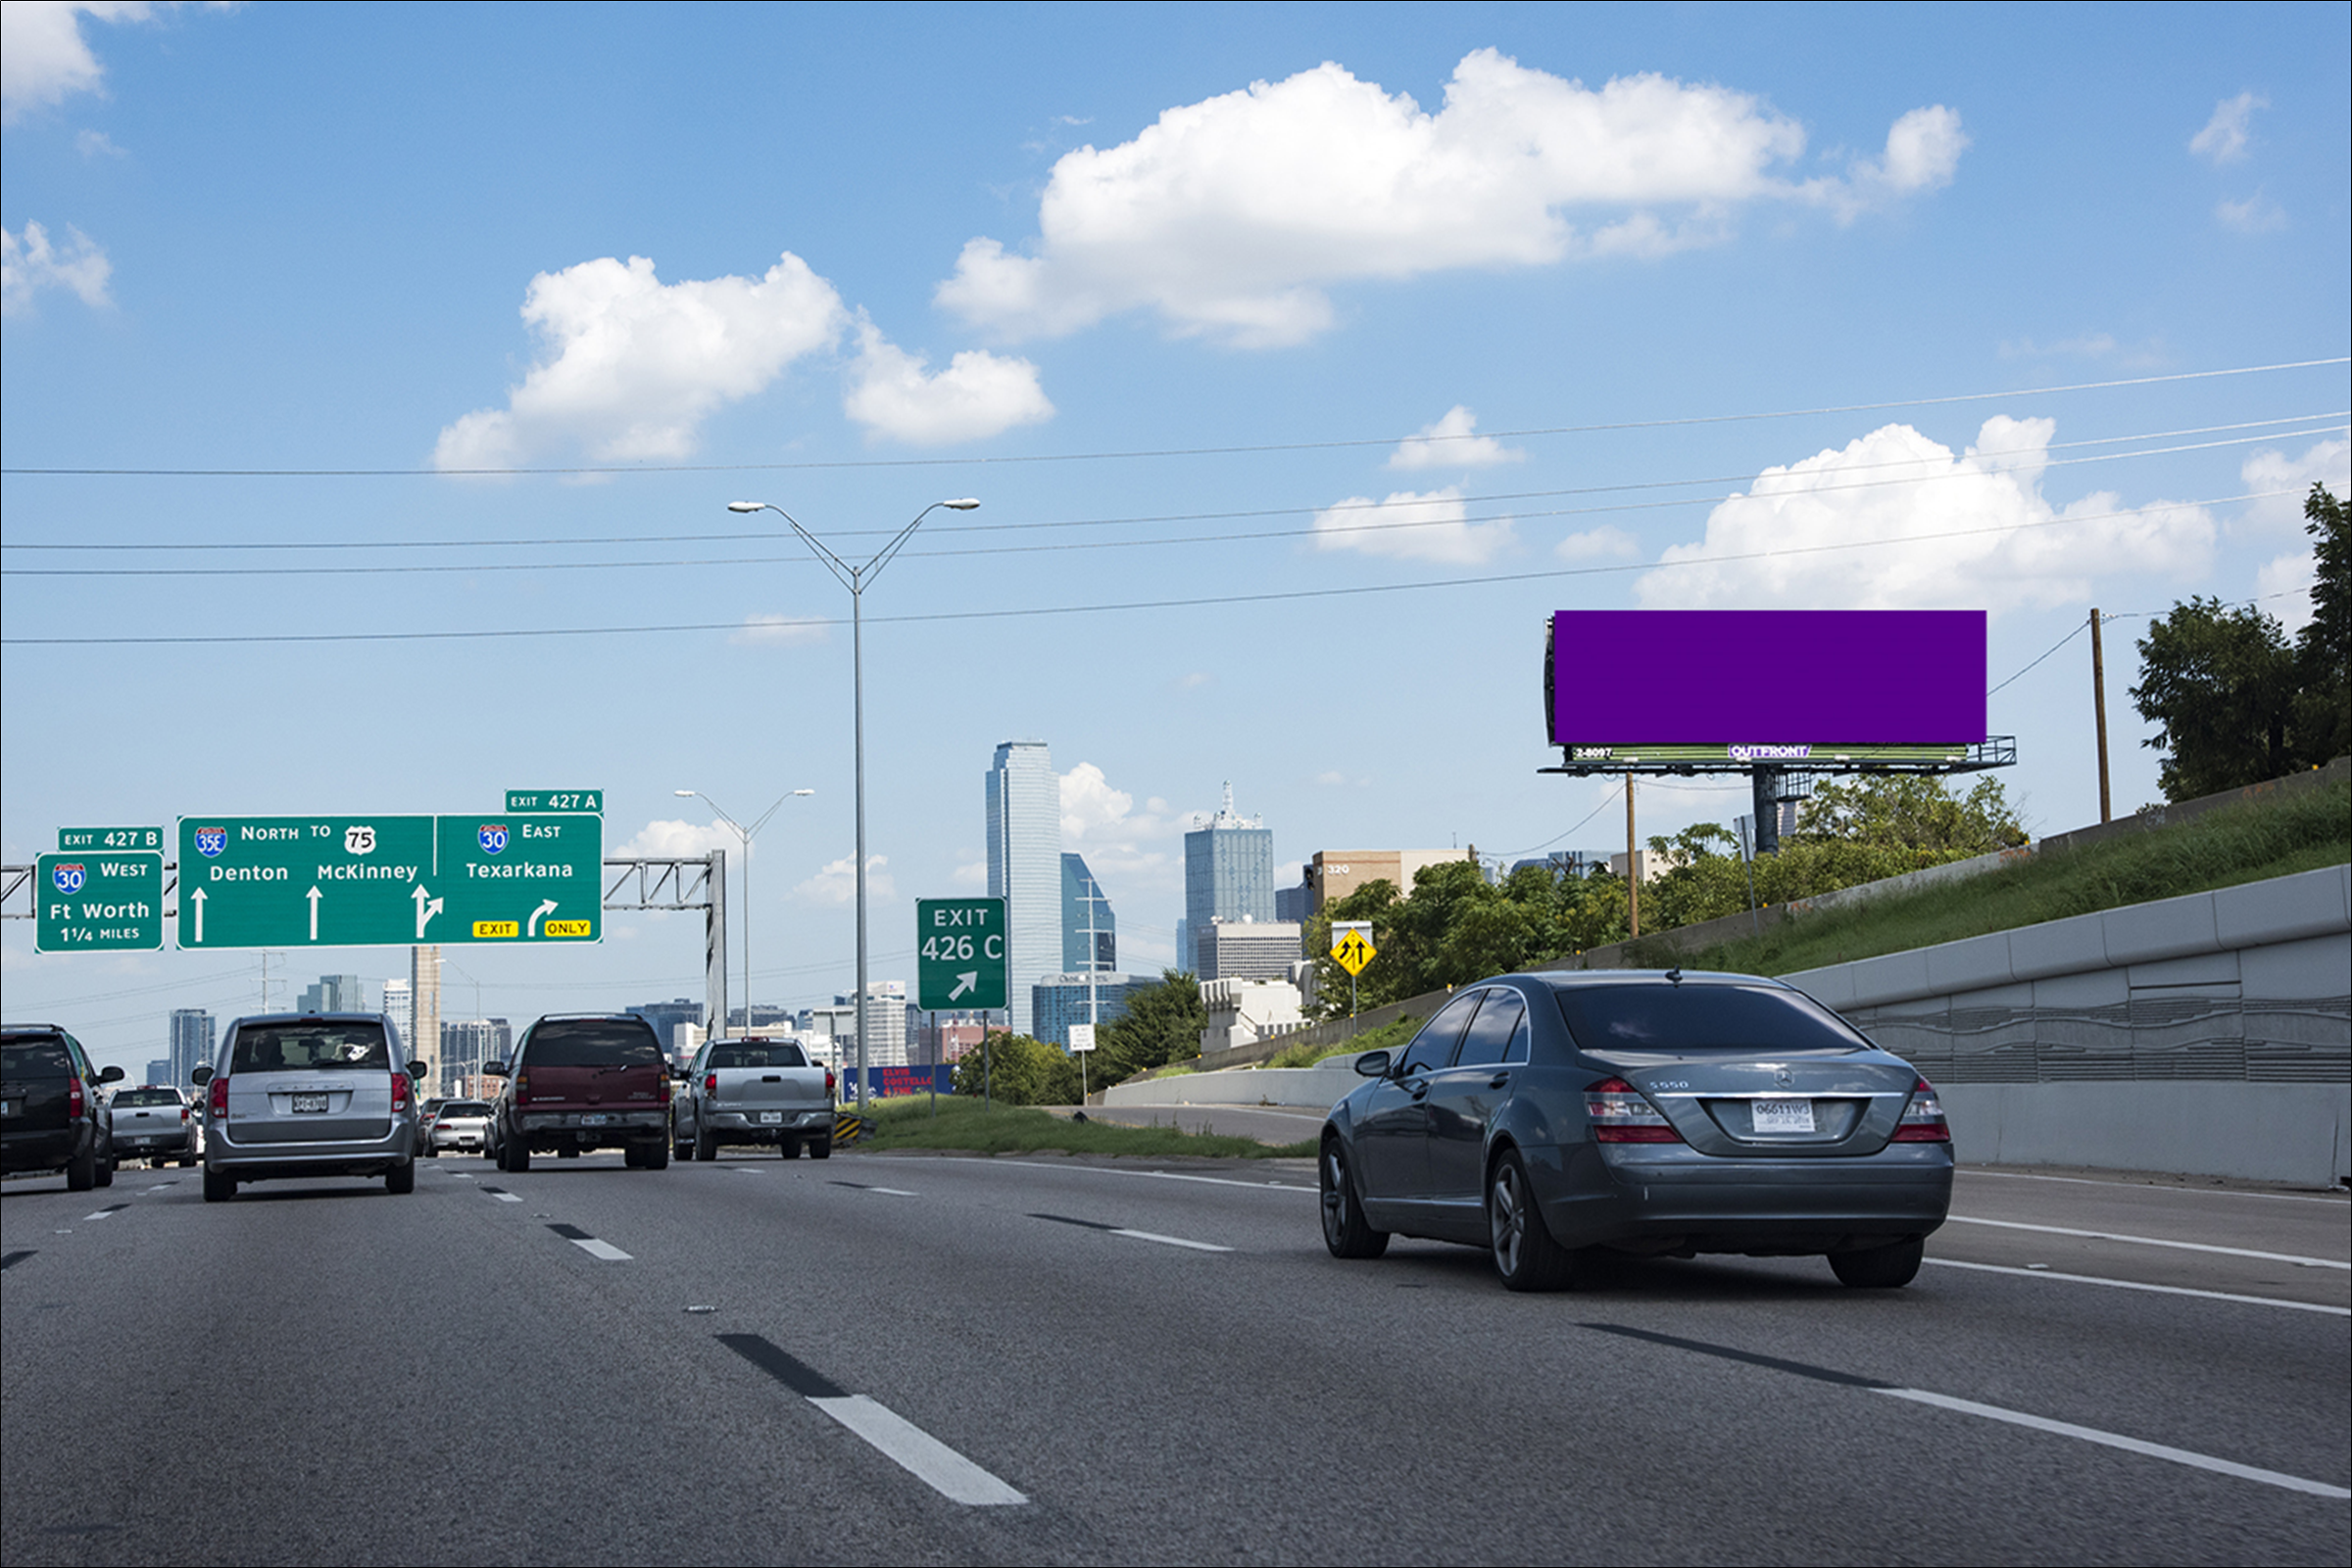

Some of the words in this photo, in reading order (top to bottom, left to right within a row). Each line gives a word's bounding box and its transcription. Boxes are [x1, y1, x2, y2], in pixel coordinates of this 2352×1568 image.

[1731, 745, 1807, 757] OUTFRONT
[511, 796, 538, 808] EXIT
[548, 794, 580, 808] 427
[584, 794, 597, 808] A
[65, 834, 93, 845] EXIT
[104, 831, 138, 847] 427
[146, 831, 157, 846] B
[199, 834, 221, 853] 35E
[241, 826, 299, 840] NORTH
[310, 825, 331, 837] TO
[348, 832, 372, 849] 75
[482, 831, 506, 849] 30
[522, 823, 562, 838] EAST
[58, 871, 82, 889] 30
[100, 862, 148, 877] WEST
[210, 864, 288, 881] Denton
[318, 863, 417, 883] McKinney
[466, 861, 573, 878] Texarkana
[1327, 864, 1349, 875] 320
[50, 904, 72, 920] Ft
[82, 902, 149, 918] Worth
[934, 908, 988, 926] EXIT
[100, 928, 139, 940] MILES
[479, 923, 513, 935] EXIT
[547, 922, 588, 935] ONLY
[921, 935, 974, 960] 426
[984, 934, 1003, 959] C
